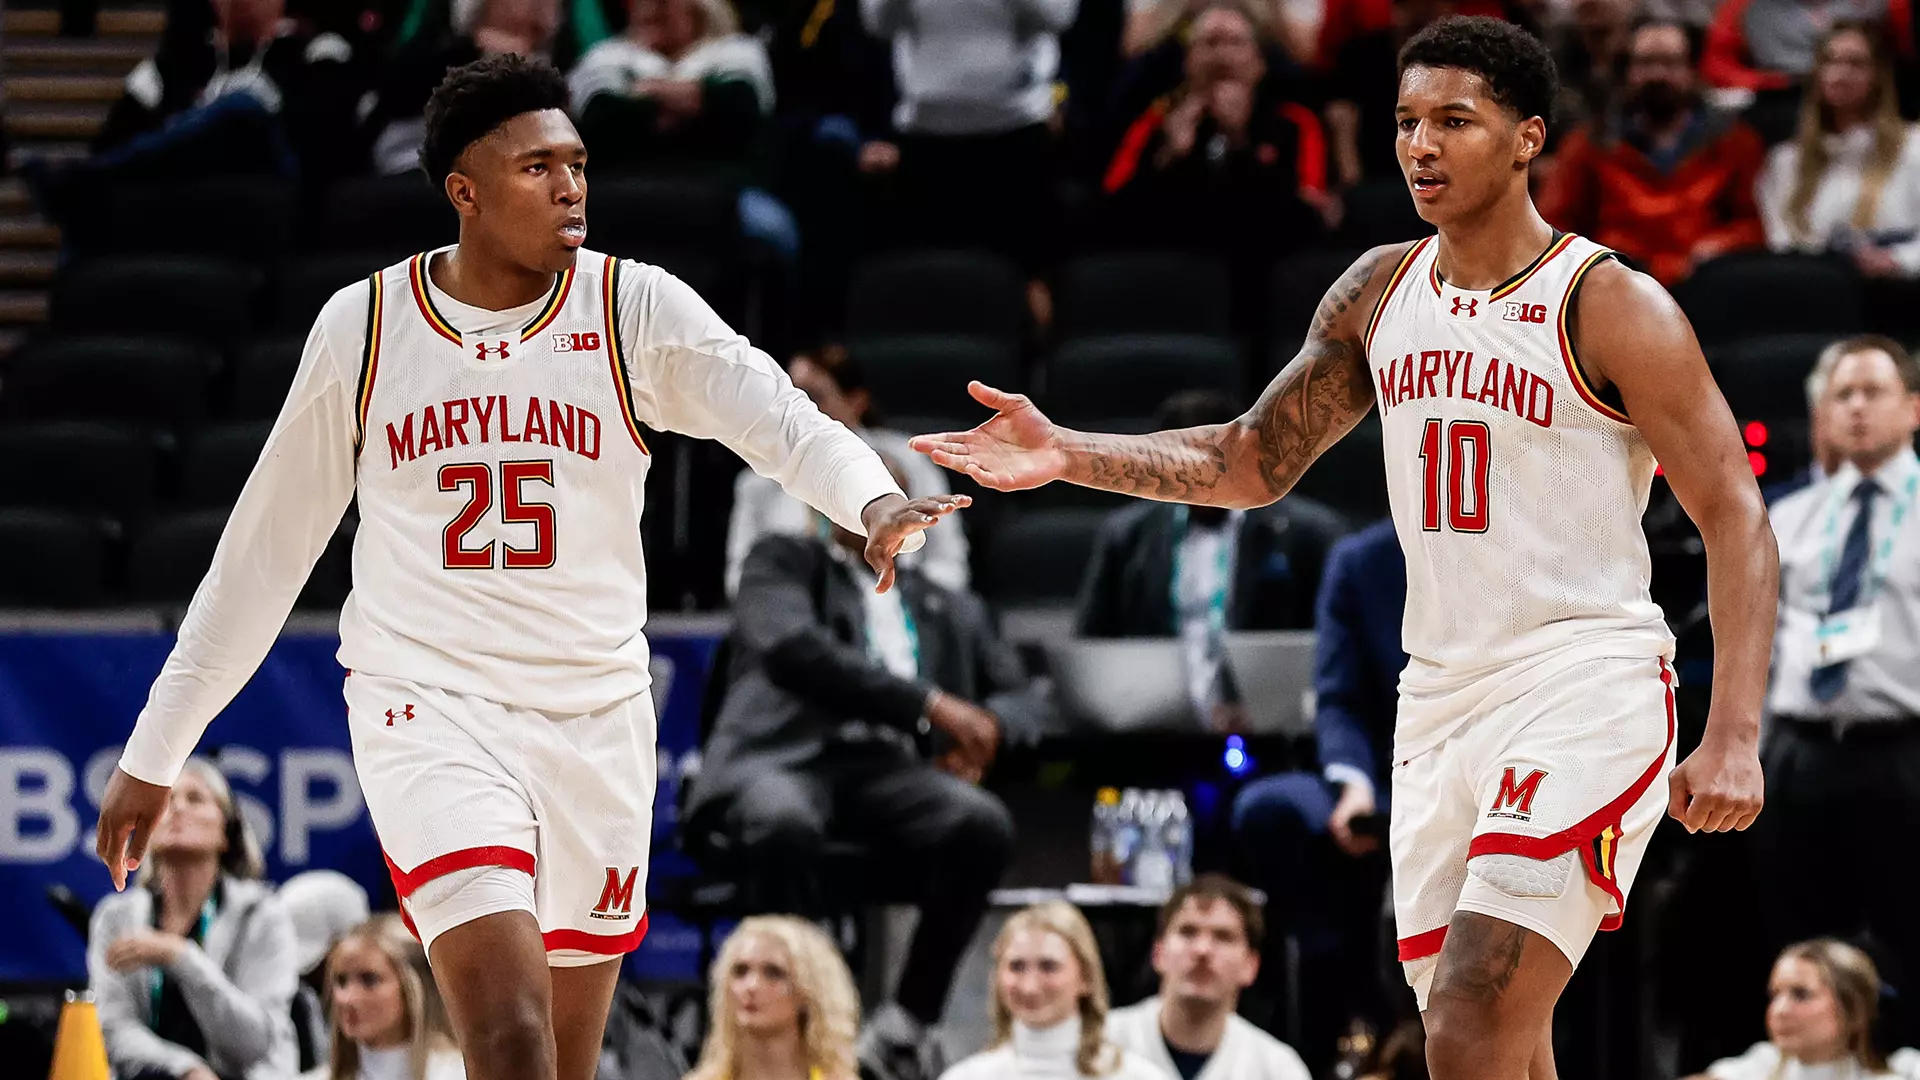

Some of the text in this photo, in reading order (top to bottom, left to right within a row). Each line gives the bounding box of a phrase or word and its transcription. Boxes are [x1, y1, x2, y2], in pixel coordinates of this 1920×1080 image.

[1379, 350, 1554, 428] MARYLAND
[386, 395, 601, 470] MARYLAND
[1419, 418, 1491, 533] 10
[438, 459, 556, 569] 25
[1490, 767, 1549, 815] M
[593, 866, 639, 912] M
